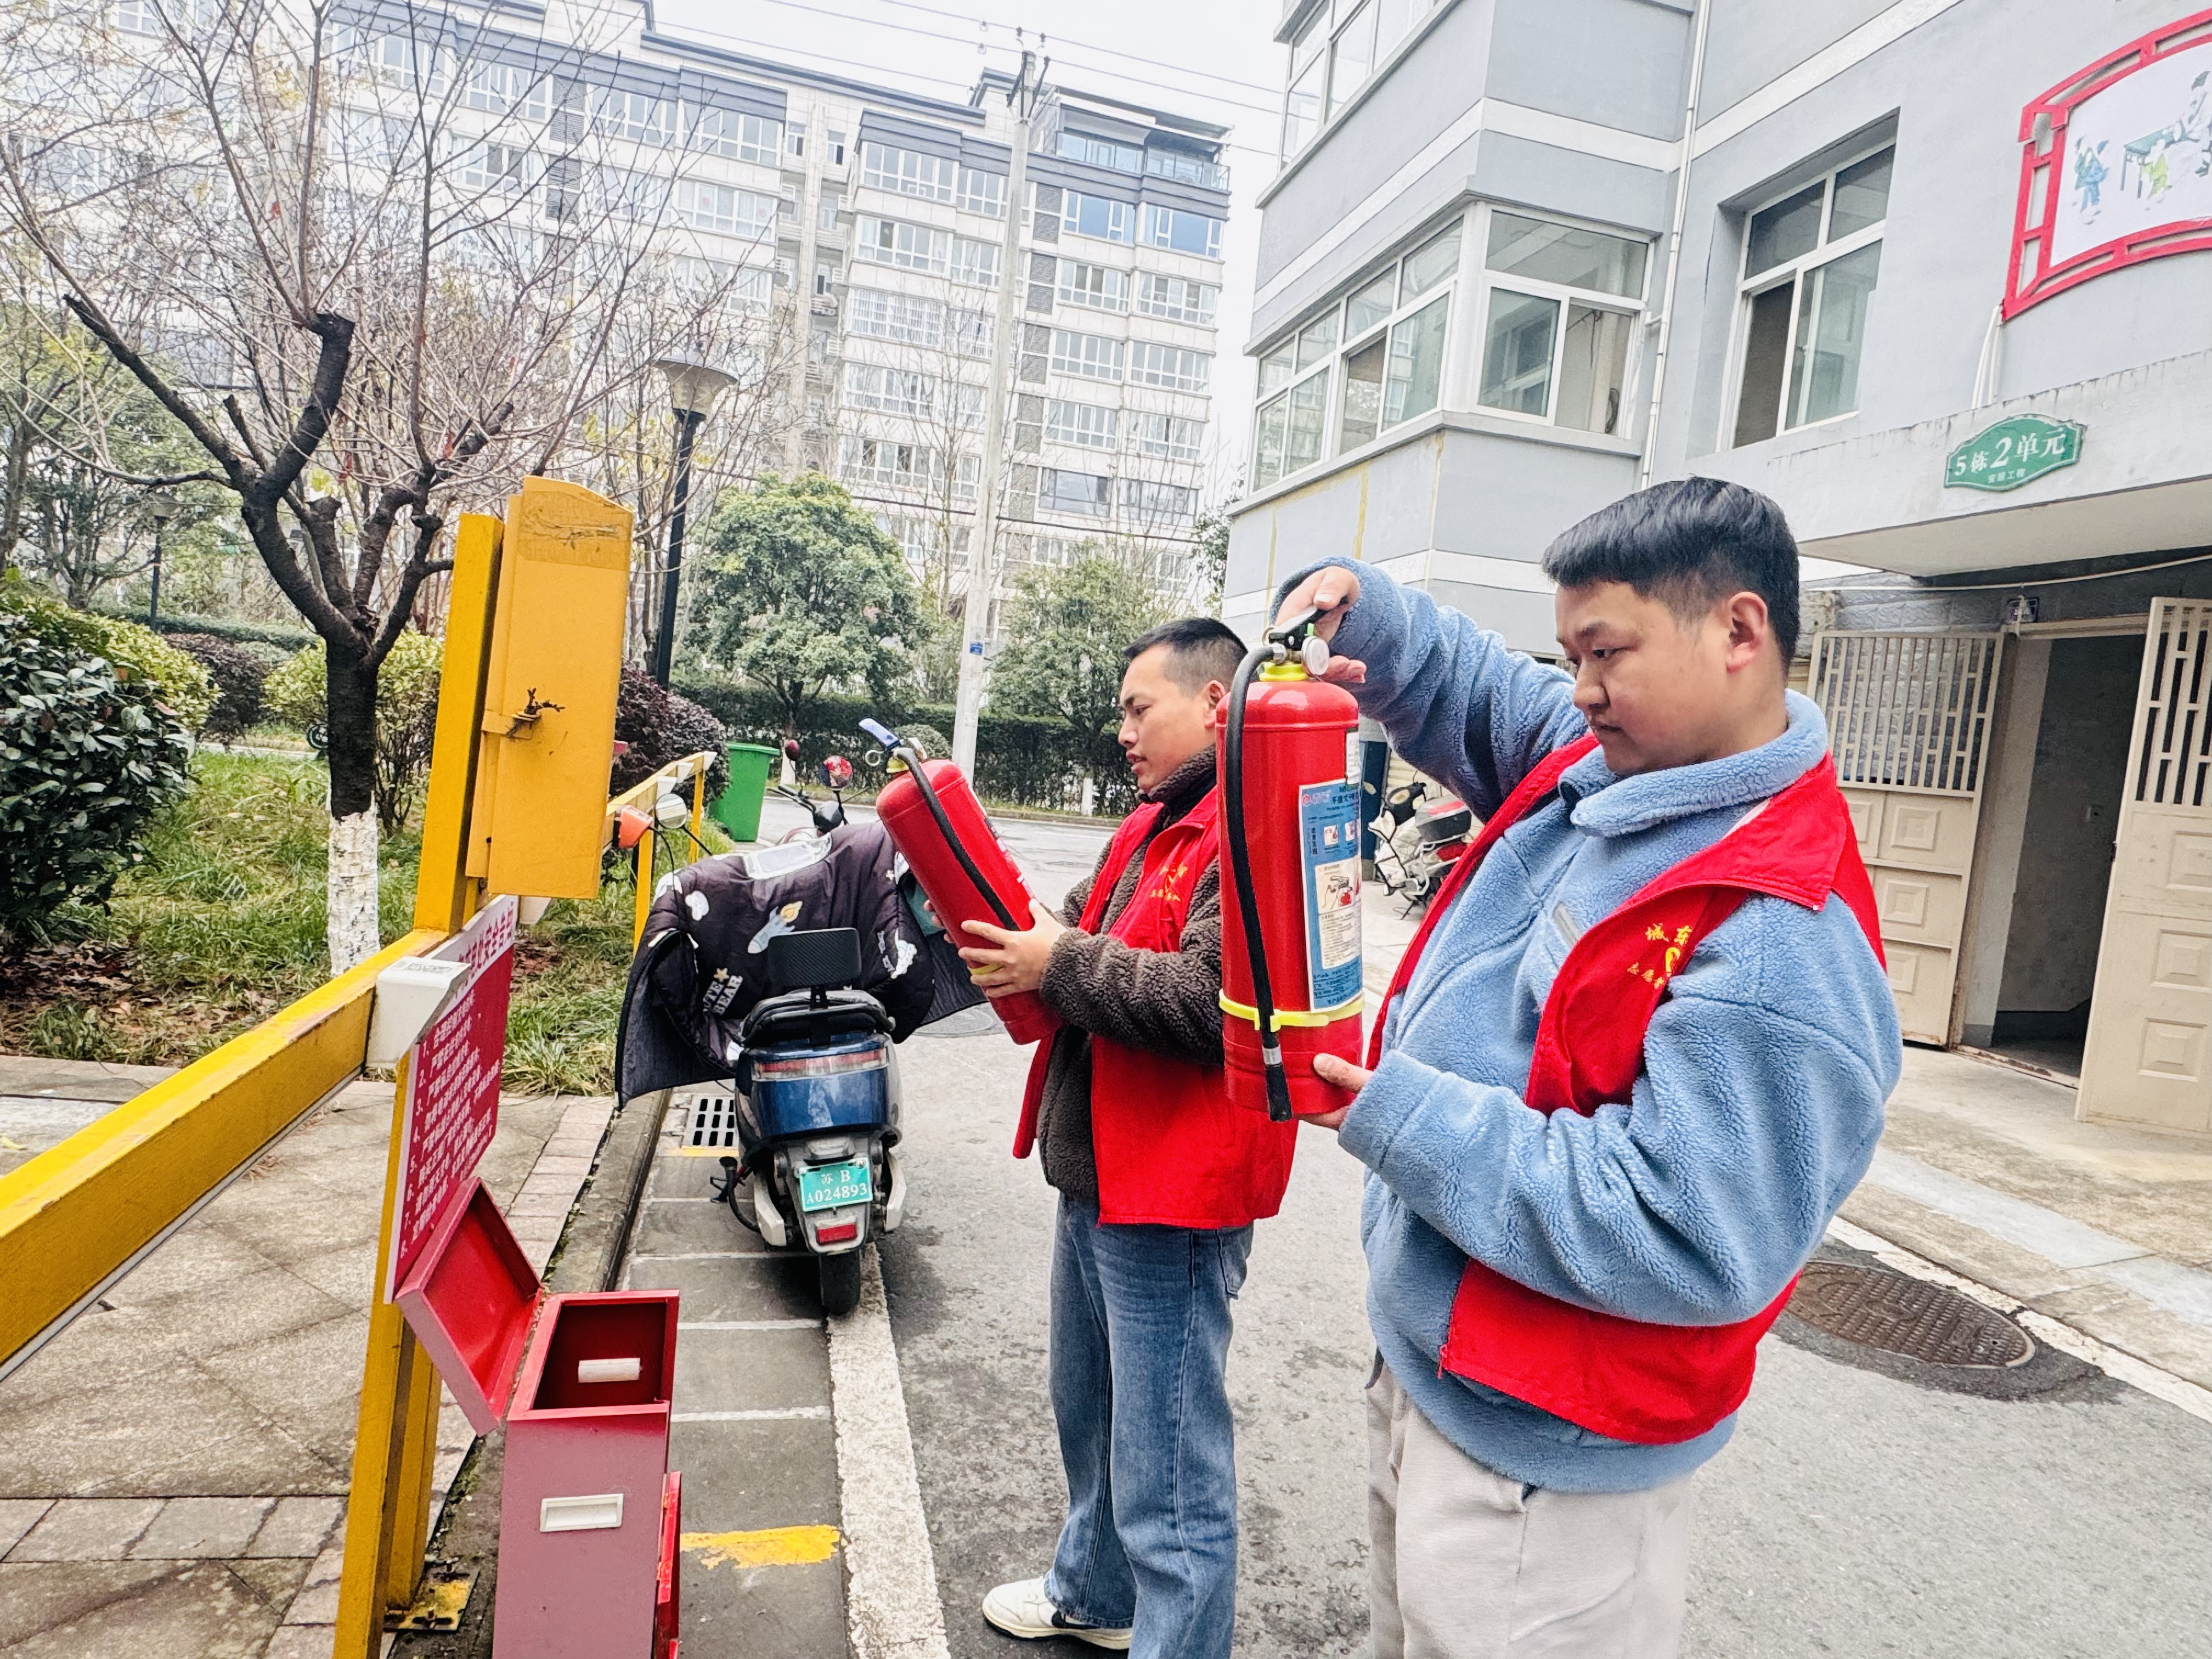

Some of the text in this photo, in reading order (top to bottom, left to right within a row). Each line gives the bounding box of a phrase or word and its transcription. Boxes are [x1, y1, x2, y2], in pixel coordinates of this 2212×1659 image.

[1954, 427, 2066, 476] 5栋2单元
[703, 981, 724, 1012] UTE
[713, 975, 743, 1015] BEAR
[806, 1183, 867, 1205] A024893
